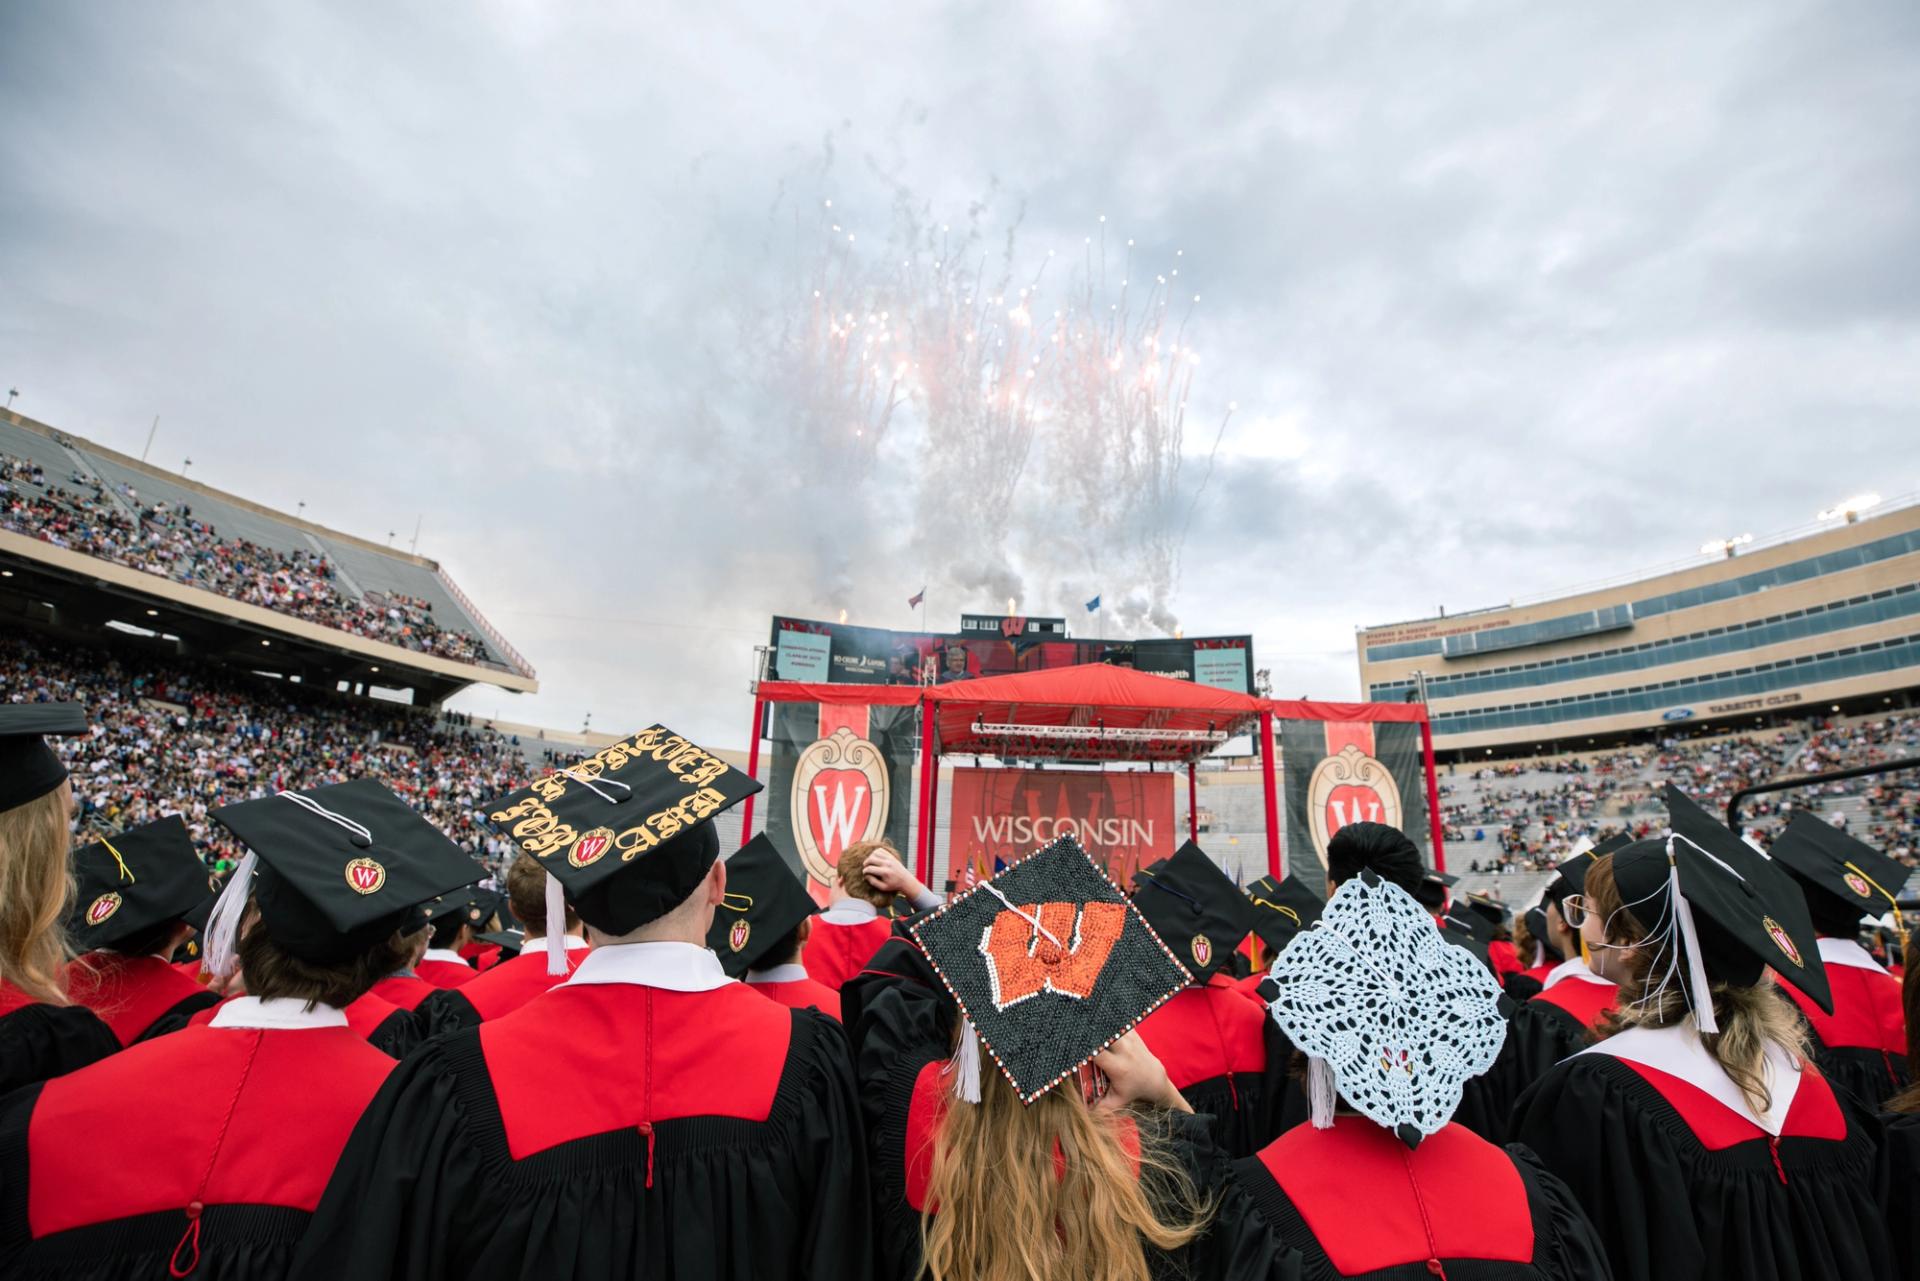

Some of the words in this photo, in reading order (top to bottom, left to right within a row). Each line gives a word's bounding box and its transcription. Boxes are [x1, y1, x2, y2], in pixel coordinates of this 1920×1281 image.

[1709, 698, 1763, 713] VARSITY
[1765, 693, 1802, 705] CLUB
[814, 781, 867, 854] W
[972, 815, 1155, 847] WISCONSIN
[979, 900, 1128, 1013] W
